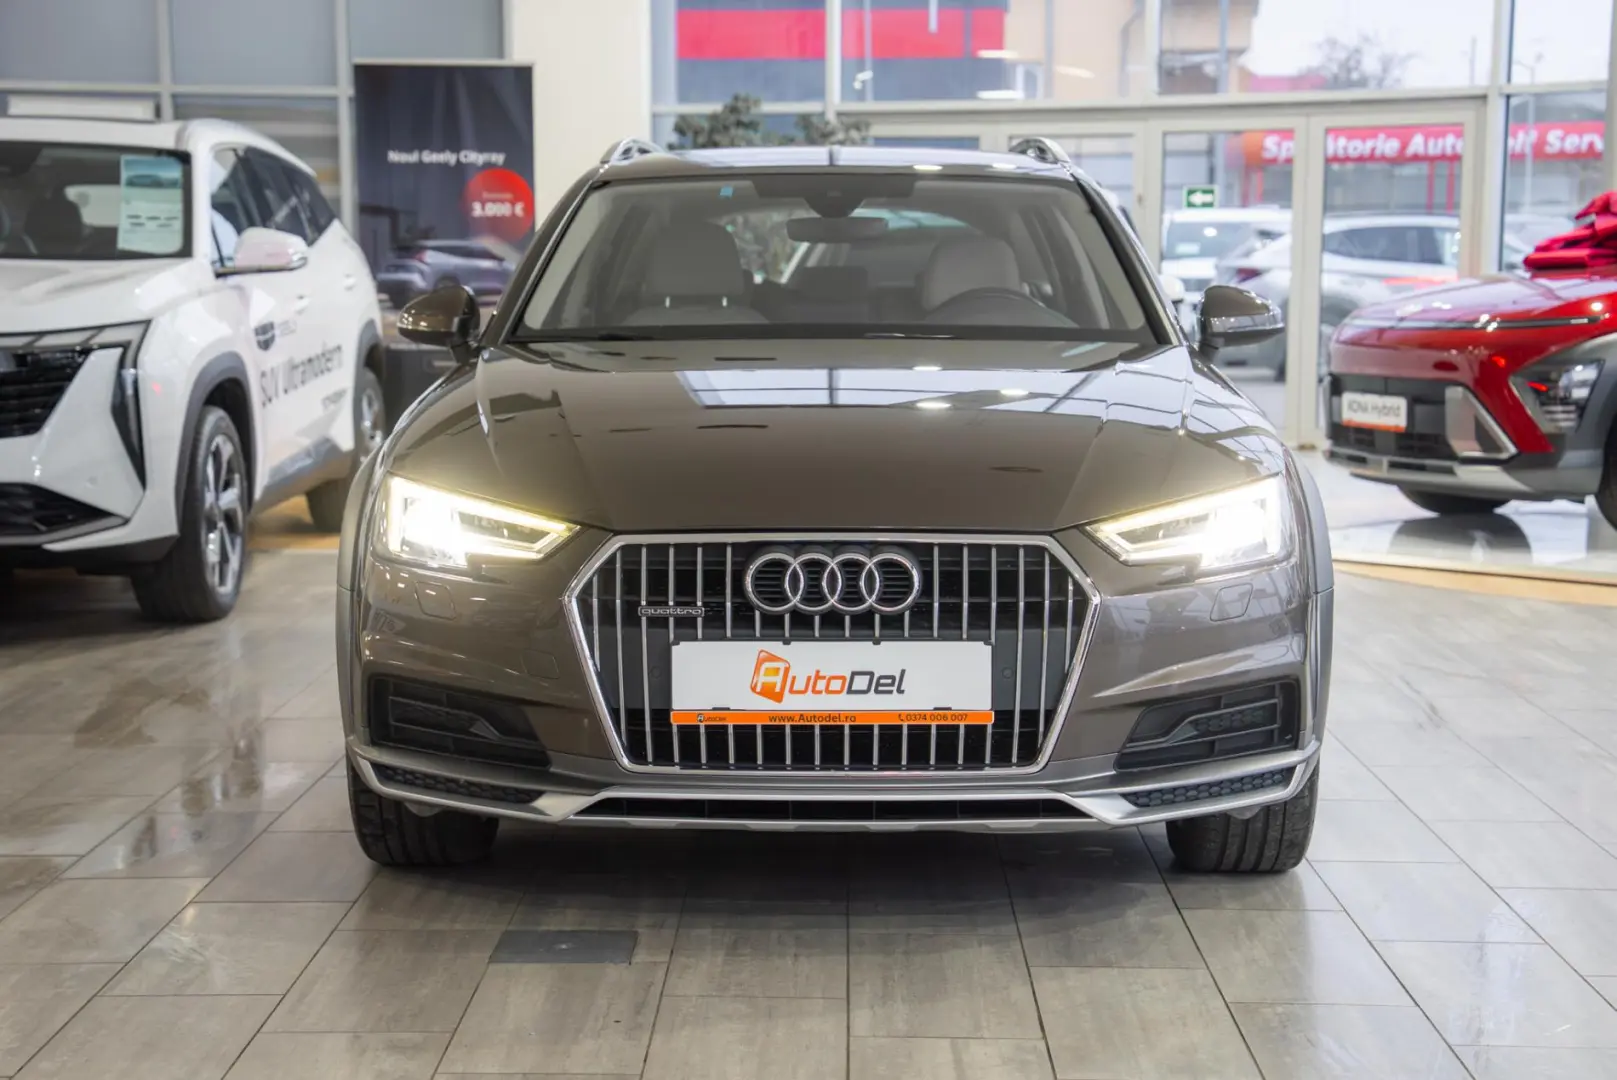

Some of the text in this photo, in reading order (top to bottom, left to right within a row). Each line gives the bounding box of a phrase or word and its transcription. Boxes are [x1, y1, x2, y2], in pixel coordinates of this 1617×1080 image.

[387, 150, 506, 167] Noul Geely Cityray
[641, 607, 702, 617] quattro
[751, 654, 906, 700] AutoDel
[768, 713, 857, 724] www.Autodel.ro
[906, 713, 968, 722] 0374 006 007
